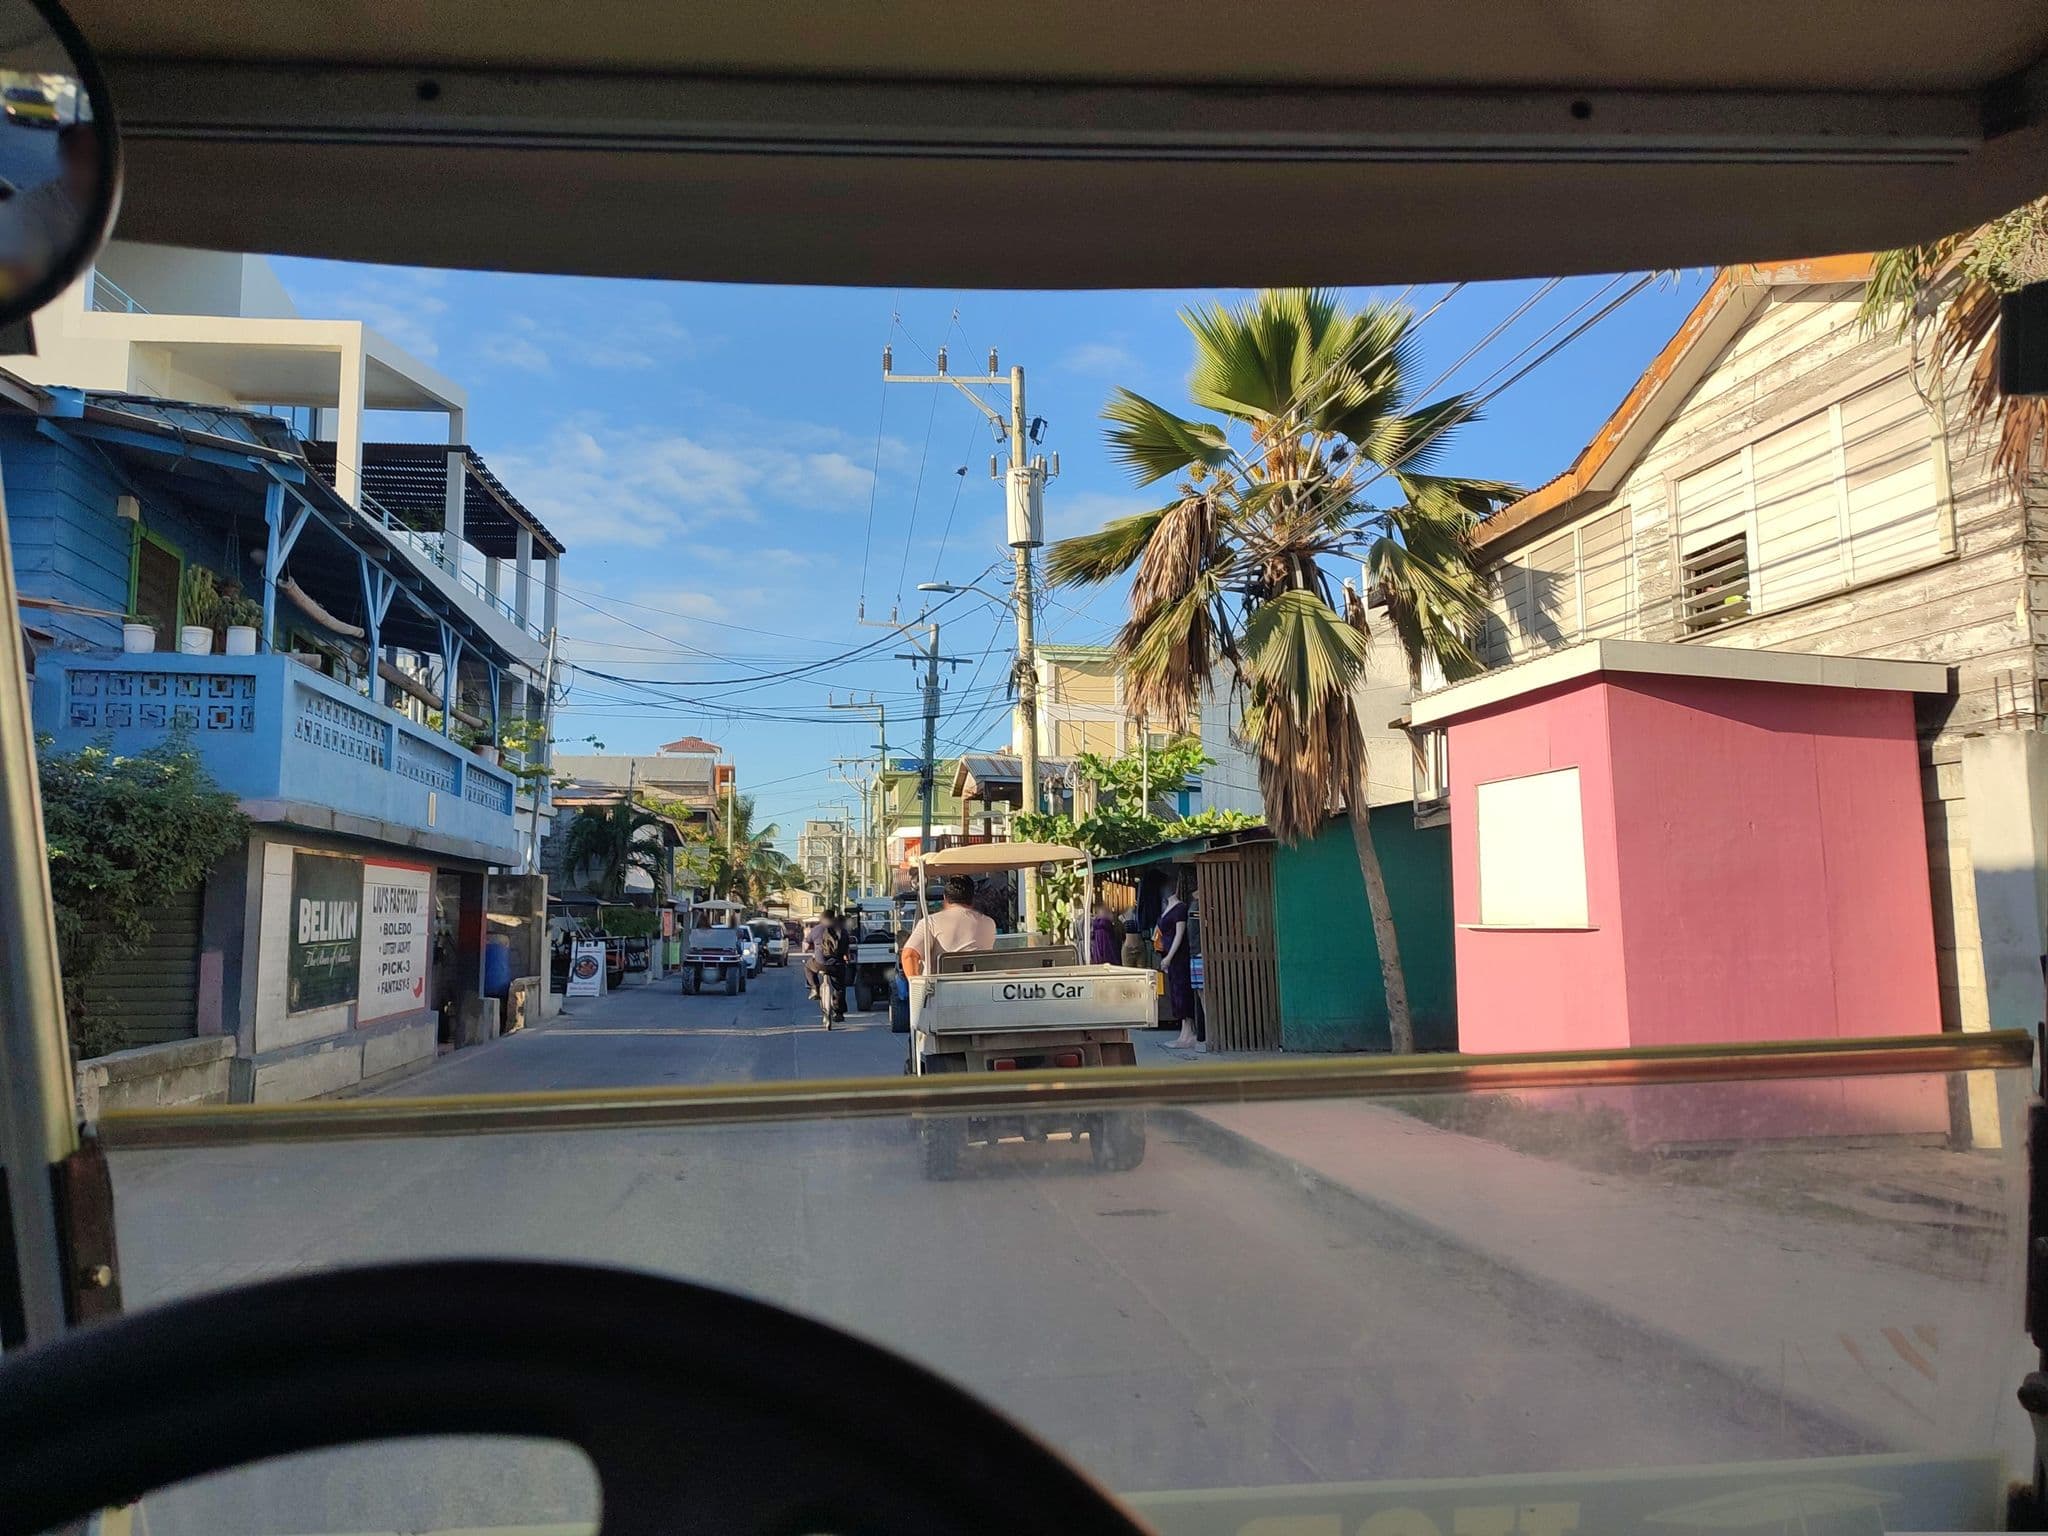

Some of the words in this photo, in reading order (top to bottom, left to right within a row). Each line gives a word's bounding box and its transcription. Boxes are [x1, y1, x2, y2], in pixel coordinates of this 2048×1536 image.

[389, 887, 418, 914] FASTFOOD
[298, 898, 358, 944] BELIKIN
[383, 923, 412, 936] BOLEDO
[382, 960, 411, 976] PICK-3
[381, 978, 410, 994] FANTASY-5
[1003, 984, 1046, 999] Club
[1052, 983, 1085, 998] Car
